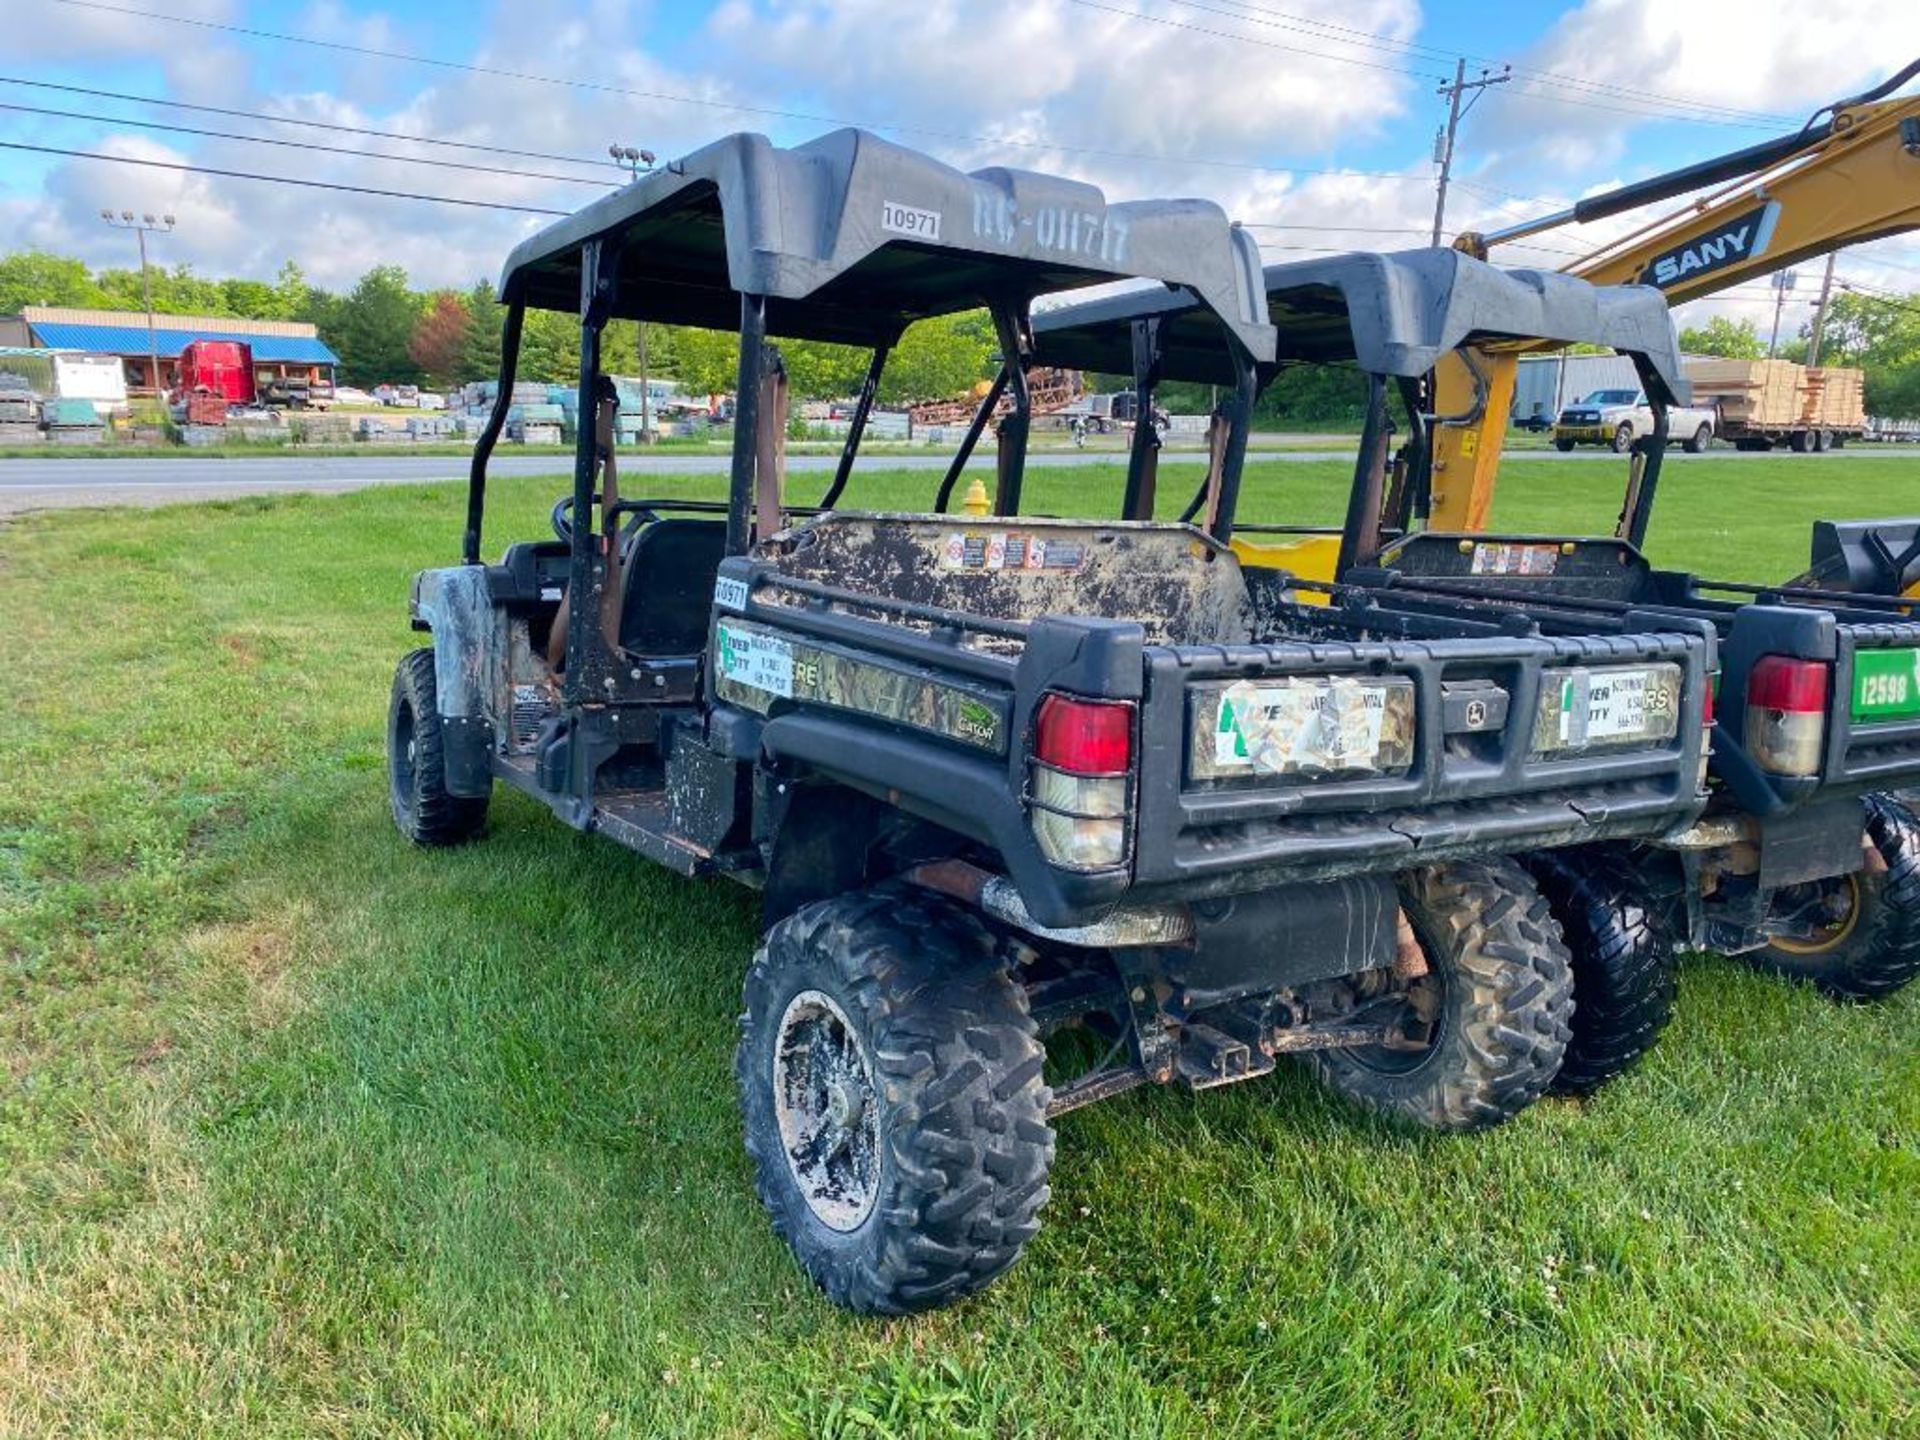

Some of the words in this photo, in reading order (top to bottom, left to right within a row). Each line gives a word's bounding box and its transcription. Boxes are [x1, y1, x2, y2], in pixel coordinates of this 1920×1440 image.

[884, 206, 936, 235] 10971
[1654, 225, 1751, 284] SANY
[1861, 674, 1908, 705] 12598
